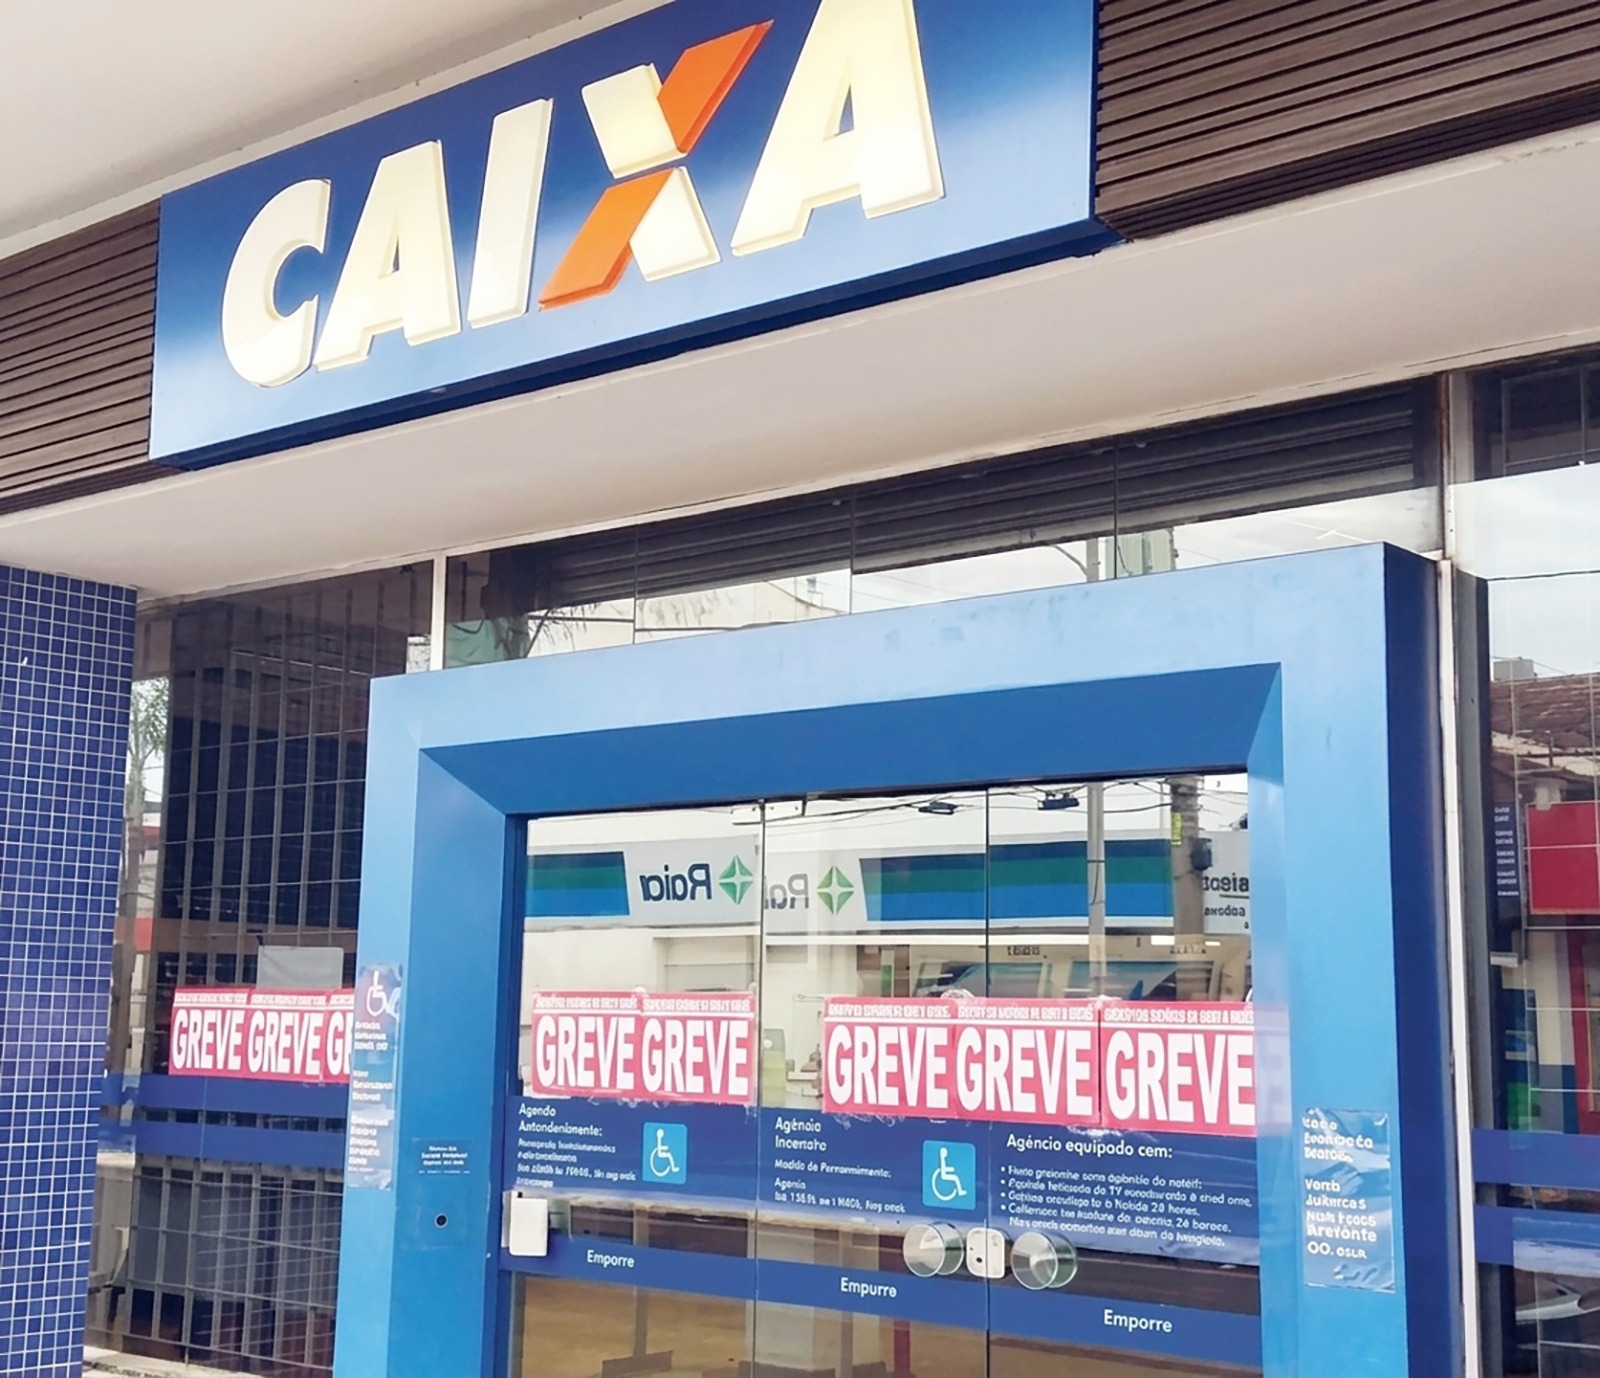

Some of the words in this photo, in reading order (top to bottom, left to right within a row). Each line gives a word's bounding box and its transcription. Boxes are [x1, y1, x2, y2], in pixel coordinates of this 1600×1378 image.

[221, 0, 946, 388] CAIXA
[172, 1009, 246, 1071] GREVE
[248, 1010, 325, 1076] GREVE
[535, 1014, 636, 1091] GREVE
[641, 1017, 749, 1096] GREVE
[827, 1023, 949, 1109] GREVE
[956, 1026, 1094, 1117] GREVE
[1105, 1029, 1256, 1126] GREVE
[840, 1277, 898, 1299] Empurre
